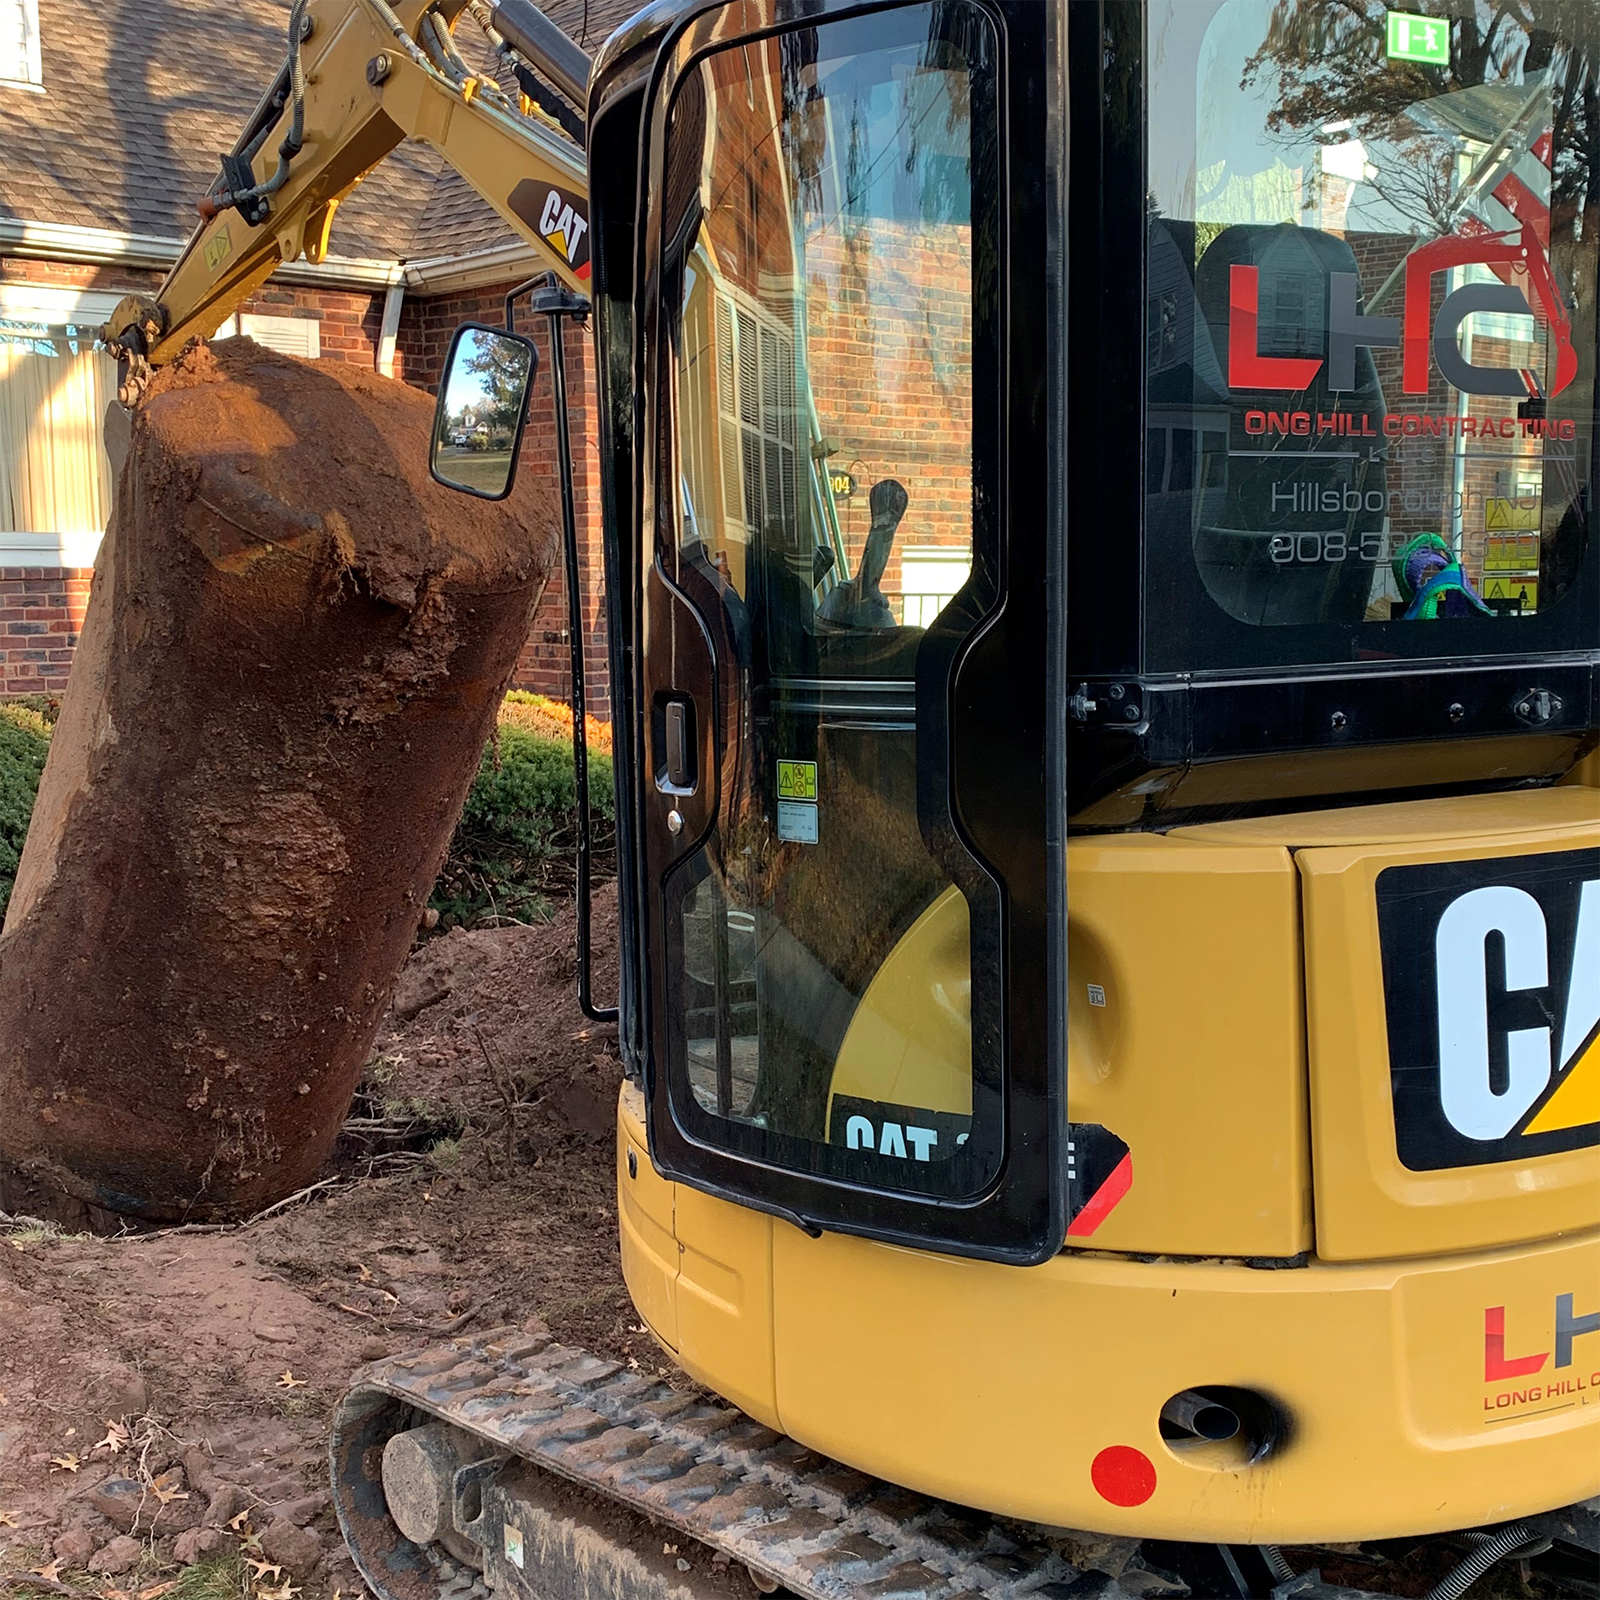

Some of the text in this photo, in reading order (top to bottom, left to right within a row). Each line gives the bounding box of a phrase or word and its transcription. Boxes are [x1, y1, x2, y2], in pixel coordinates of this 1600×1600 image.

[539, 190, 588, 264] CAT
[1317, 413, 1376, 437] HILL
[1383, 414, 1576, 441] CONTRACTING
[1271, 482, 1537, 519] Hillsborough NJ
[1484, 1387, 1542, 1411] LONG
[1547, 1377, 1587, 1399] HILL
